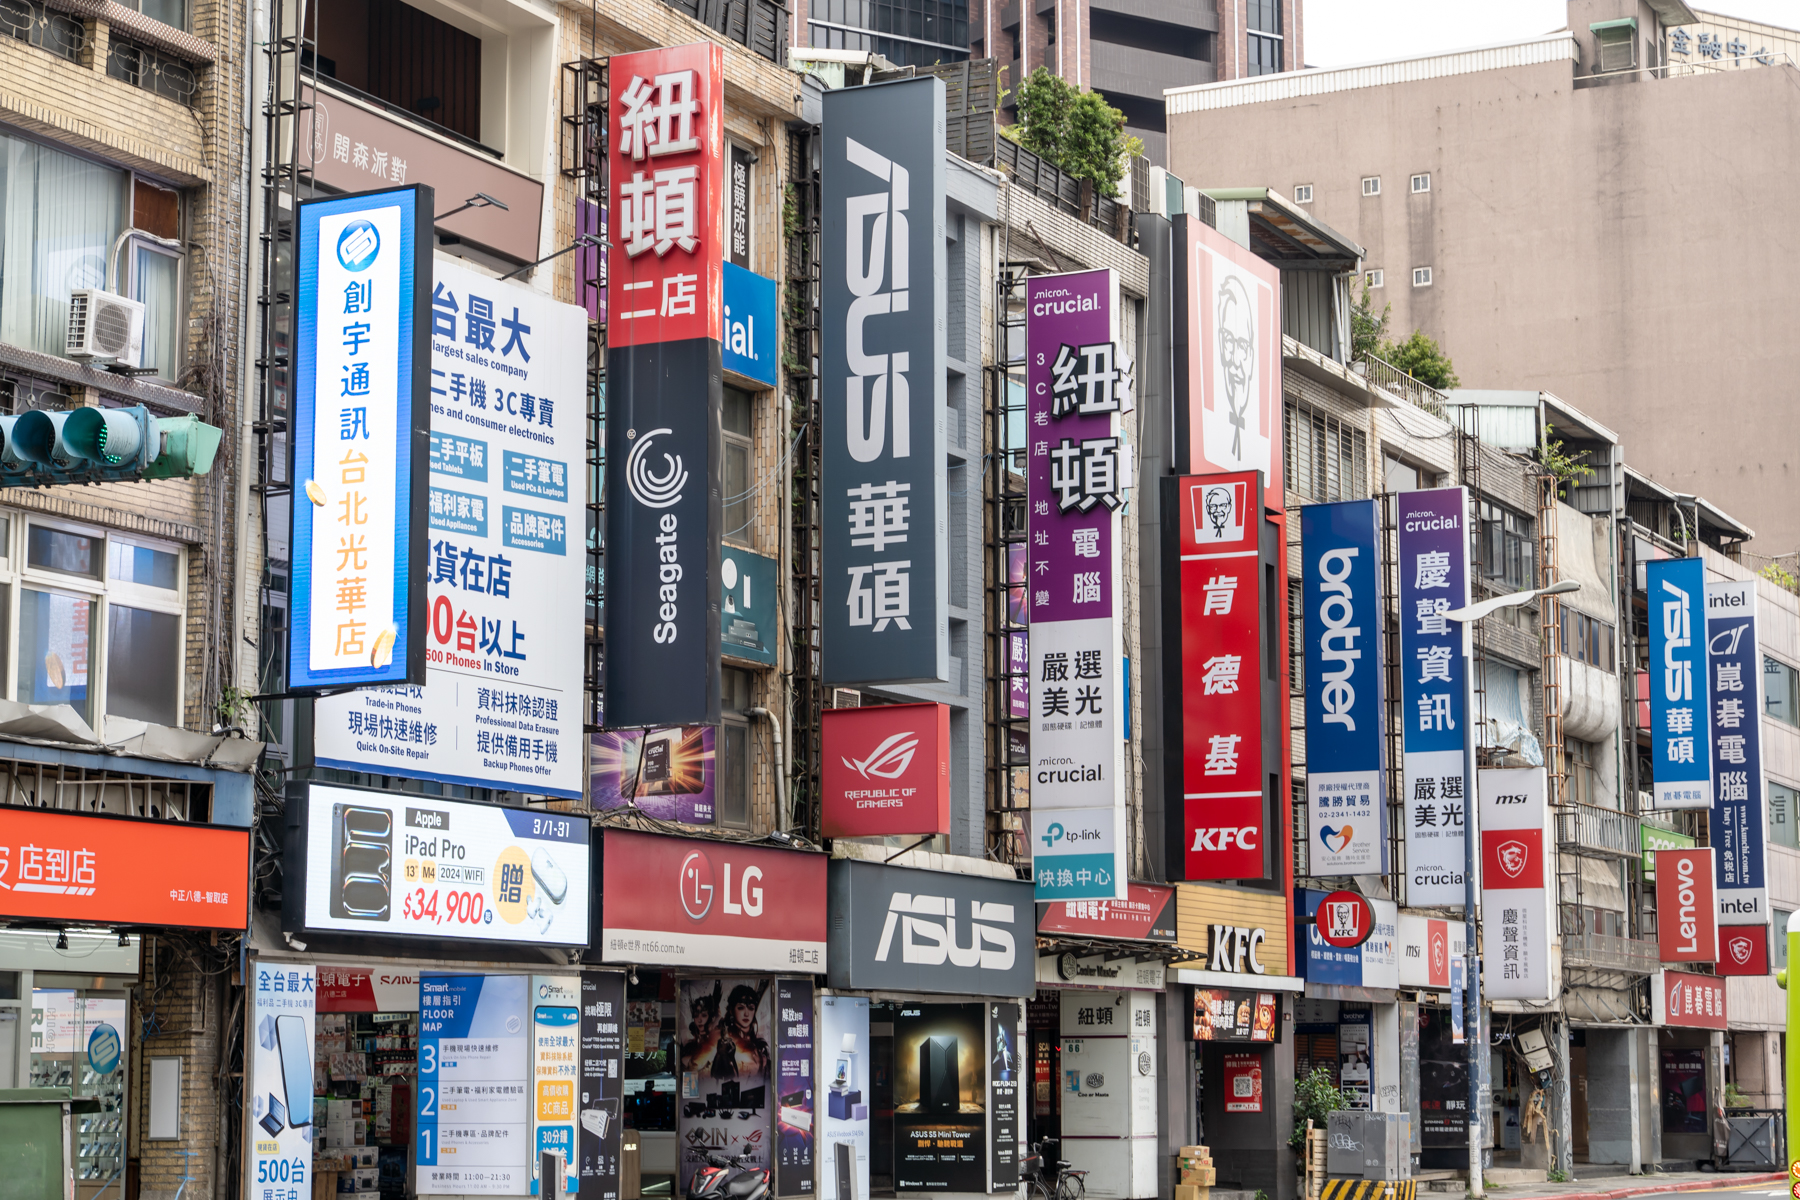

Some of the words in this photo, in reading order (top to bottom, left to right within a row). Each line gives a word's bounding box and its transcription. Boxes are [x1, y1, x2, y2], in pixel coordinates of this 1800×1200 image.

[1669, 26, 1775, 66] 金融中心
[333, 132, 407, 185] 開森派對
[619, 69, 701, 260] 紐頓
[733, 161, 746, 257] 極競所能
[621, 273, 698, 320] 二店
[846, 136, 910, 463] ASUS
[1034, 293, 1101, 316] crucial
[433, 339, 464, 359] largest
[466, 353, 489, 367] sales
[490, 361, 528, 381] company
[431, 369, 487, 410] 二手機
[494, 388, 554, 429] 3C專賣
[447, 409, 463, 420] and
[465, 413, 507, 432] consumer
[509, 425, 555, 445] electronics
[1049, 342, 1121, 514] 紐頓
[430, 437, 483, 468] 二手平板
[335, 279, 372, 656] 創宇通訊台北光華店
[442, 463, 463, 475] Tablets
[510, 457, 564, 487] 二手筆電
[511, 481, 526, 491] Used
[526, 483, 537, 494] PCs
[538, 485, 542, 494] &
[543, 486, 564, 498] Laptops
[429, 490, 484, 522] 福利家電
[1406, 510, 1436, 519] micron
[430, 516, 445, 527] Used
[446, 518, 477, 532] Appliances
[510, 511, 564, 542] 品牌配件
[1405, 515, 1459, 532] crucial
[511, 537, 544, 549] Accessories
[846, 480, 912, 633] 華碩
[1072, 527, 1101, 604] 電腦
[653, 513, 683, 644] Seagate
[1709, 591, 1746, 609] intel
[1319, 547, 1361, 731] brother
[1414, 550, 1455, 731] 慶聲資訊
[1662, 579, 1692, 702] ASUS
[446, 652, 481, 670] Phones
[484, 659, 492, 671] In
[495, 661, 519, 676] Store
[1041, 650, 1103, 683] 嚴選
[1202, 575, 1242, 777] 肯德基
[365, 696, 394, 711] Trade-in
[395, 701, 422, 715] Phones
[477, 687, 558, 722] 資料抹除認證
[1042, 685, 1103, 718] 美光
[348, 711, 438, 746] 現場快速維修
[475, 714, 517, 730] Professional
[518, 719, 534, 732] Data
[535, 722, 560, 736] Erasure
[1042, 722, 1072, 731] 固態硬碟
[1080, 720, 1103, 730] 記憶體
[1666, 707, 1695, 764] 華碩
[356, 740, 378, 755] Quick
[379, 743, 405, 756] On-Site
[406, 746, 430, 760] Repair
[477, 730, 558, 764] 提供備用手機
[483, 758, 508, 773] Backup
[509, 760, 533, 774] Phones
[534, 764, 552, 776] Offer
[1038, 757, 1075, 766] micron
[1037, 764, 1103, 784] crucial
[845, 788, 900, 801] REPUBLIC
[902, 787, 917, 798] OF
[1318, 782, 1370, 792] 原廠授權代理商
[1414, 776, 1463, 800] 嚴選
[856, 799, 903, 809] GAMERS
[1495, 794, 1528, 805] msi
[414, 811, 442, 827] Apple
[1319, 810, 1371, 818] 02-2341-1432
[1415, 803, 1463, 827] 美光
[1723, 807, 1732, 827] Duty
[405, 834, 437, 859] iPad
[441, 838, 466, 861] Pro
[1066, 829, 1101, 843] tp-link
[1191, 826, 1257, 852] KFC
[1724, 830, 1734, 848] Free
[18, 843, 96, 884] 店到店
[422, 865, 435, 879] M4
[440, 868, 460, 880] 2024
[464, 869, 484, 882] WIFI
[1724, 850, 1735, 883] 免稅店
[499, 863, 523, 904] 贈
[1038, 867, 1111, 888] 快換中心
[723, 863, 763, 917] LG
[403, 887, 484, 925] $34,900
[1677, 858, 1697, 953] Lenovo
[1720, 897, 1758, 914] intel
[875, 892, 1016, 971] ASUS
[1333, 929, 1354, 937] KFC
[642, 940, 685, 954] nt66.com.tw
[1211, 924, 1266, 974] KFC
[1406, 944, 1421, 958] msi
[1502, 908, 1520, 980] 慶聲資訊
[789, 948, 819, 964] 紐頓二店
[258, 970, 314, 993] 全台最大
[1097, 966, 1119, 978] Master
[423, 983, 449, 992] Smart
[422, 995, 461, 1006] 樓層指引
[422, 1009, 454, 1019] FLOOR
[900, 1009, 920, 1017] ASUS
[1078, 1007, 1113, 1025] 紐頓
[422, 1022, 442, 1031] MAP
[421, 1044, 436, 1073] 3
[443, 1044, 499, 1053] 手機現場快速維修
[1068, 1044, 1080, 1052] 66
[421, 1087, 435, 1116] 2
[542, 1085, 569, 1096] 高價收購
[542, 1101, 569, 1115] 3C商品
[421, 1129, 431, 1159] 1
[542, 1129, 568, 1144] 30分鐘
[952, 1131, 971, 1139] Tower
[257, 1157, 305, 1184] 500台
[431, 1172, 460, 1180] 營業時間
